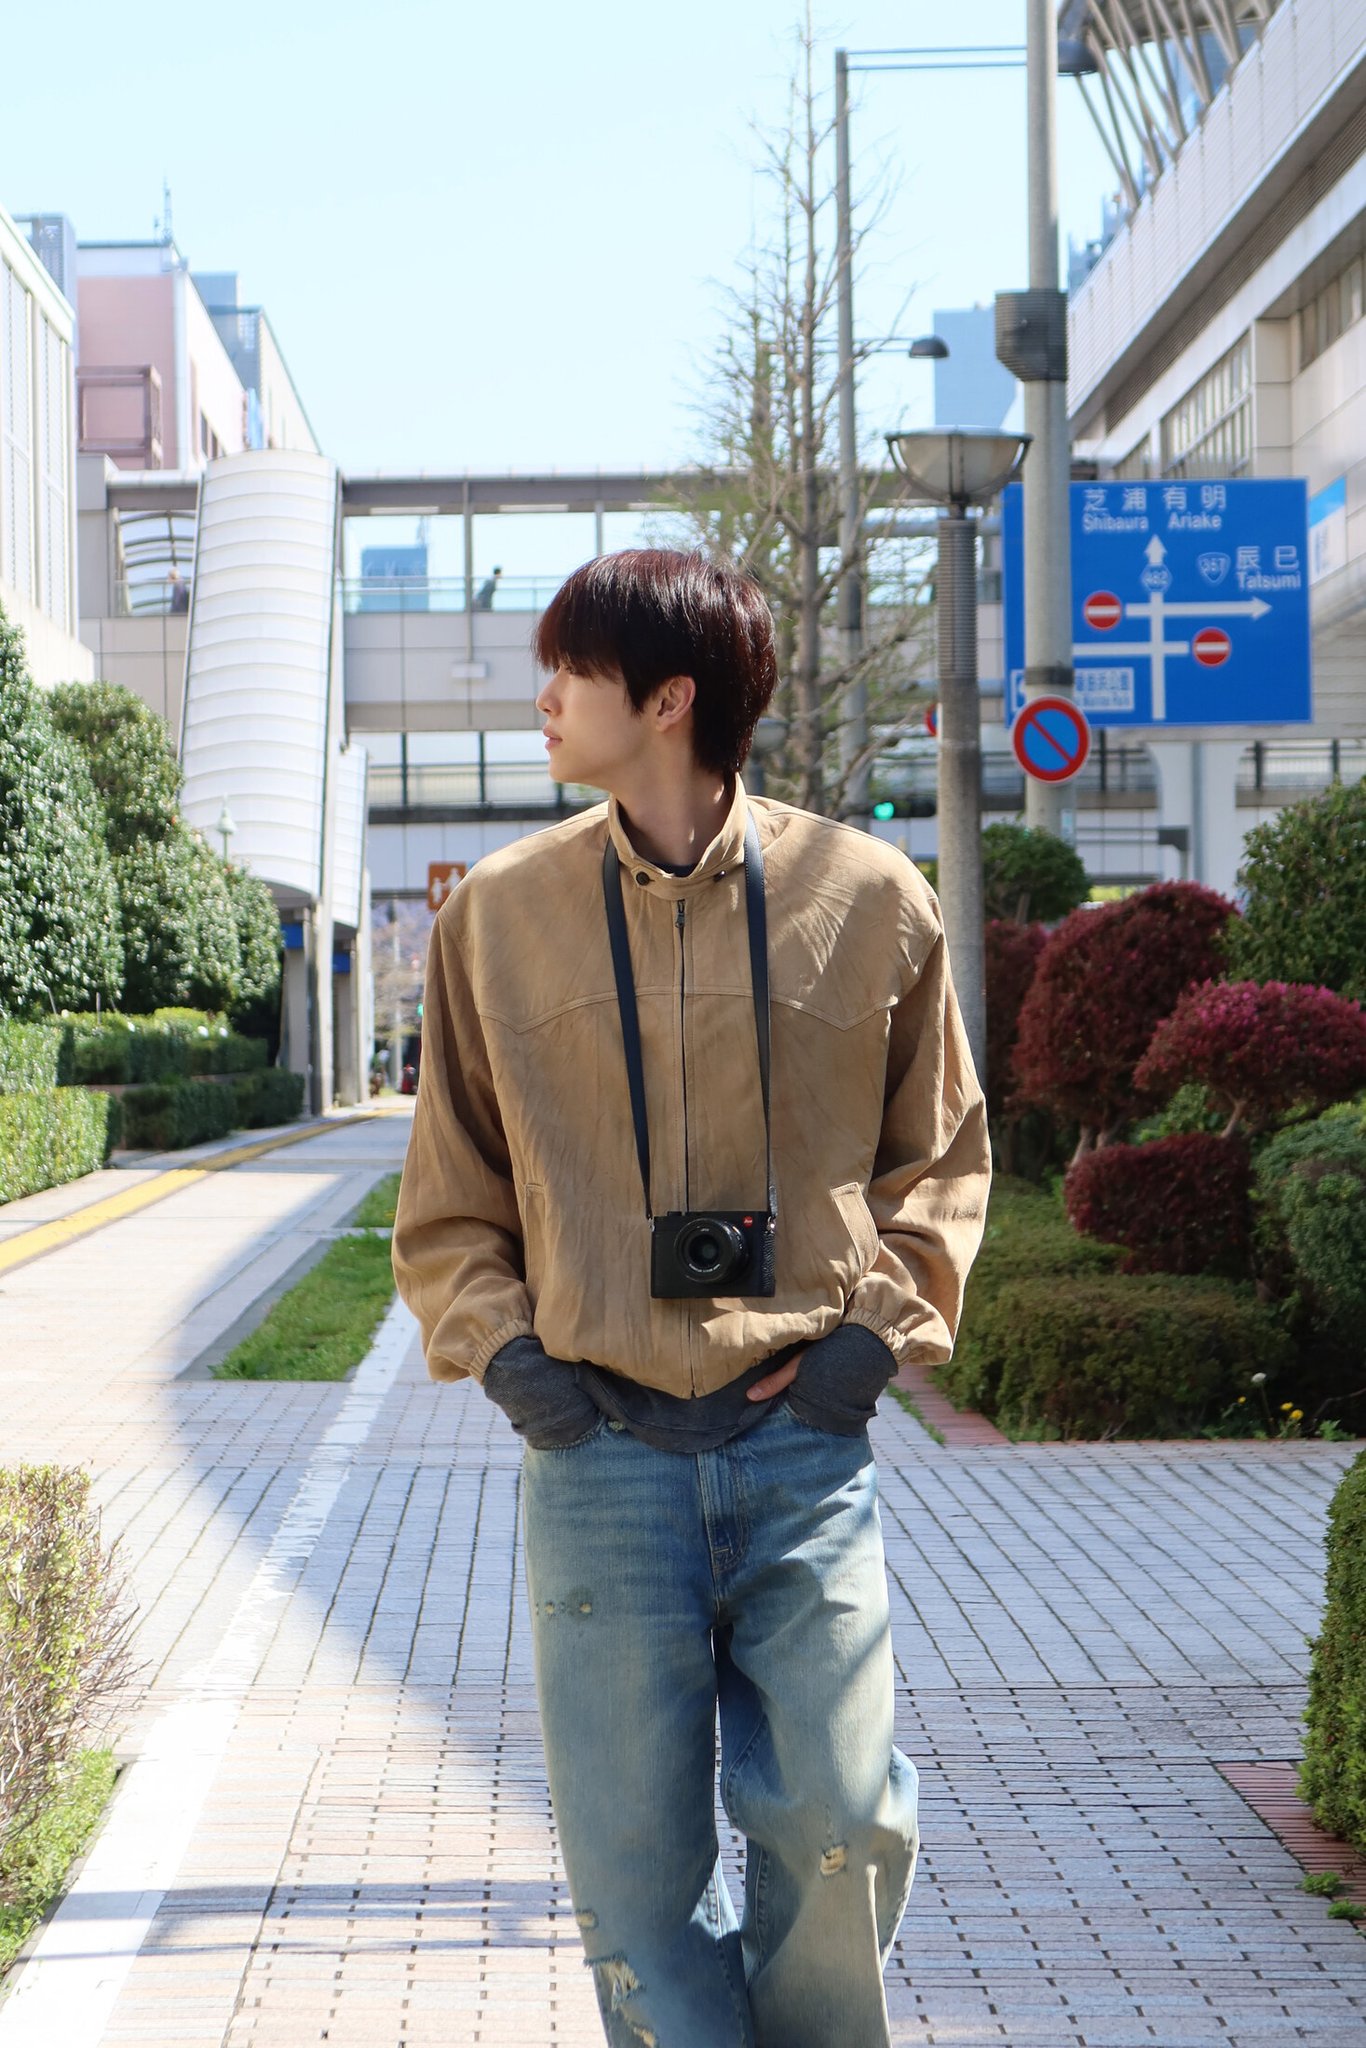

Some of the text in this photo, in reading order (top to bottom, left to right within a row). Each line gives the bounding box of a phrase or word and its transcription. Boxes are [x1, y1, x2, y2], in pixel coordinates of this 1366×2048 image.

[1083, 485, 1227, 512] 芝浦 有明
[1083, 511, 1223, 533] Shibaura Ariake
[1236, 545, 1300, 571] 辰巳
[1236, 570, 1301, 591] Tatsumi
